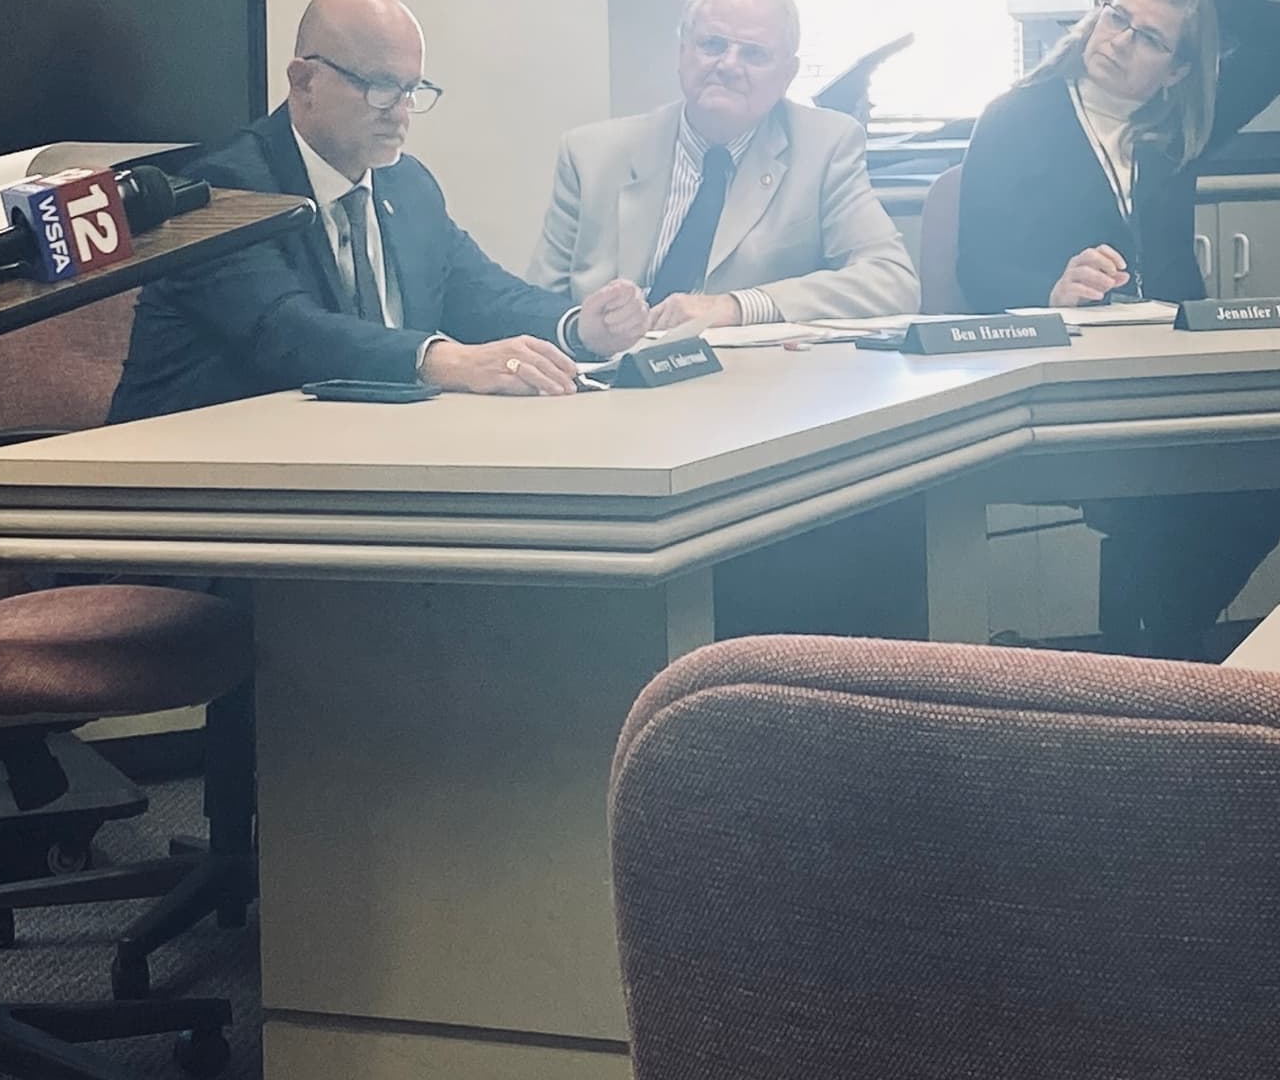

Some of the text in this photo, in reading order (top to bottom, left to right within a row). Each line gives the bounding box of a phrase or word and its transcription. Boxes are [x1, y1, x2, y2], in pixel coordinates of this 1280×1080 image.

[38, 194, 71, 274] WSFA
[66, 183, 118, 263] 12
[950, 325, 1038, 341] Ben Harrison
[1216, 306, 1272, 320] Jennifer
